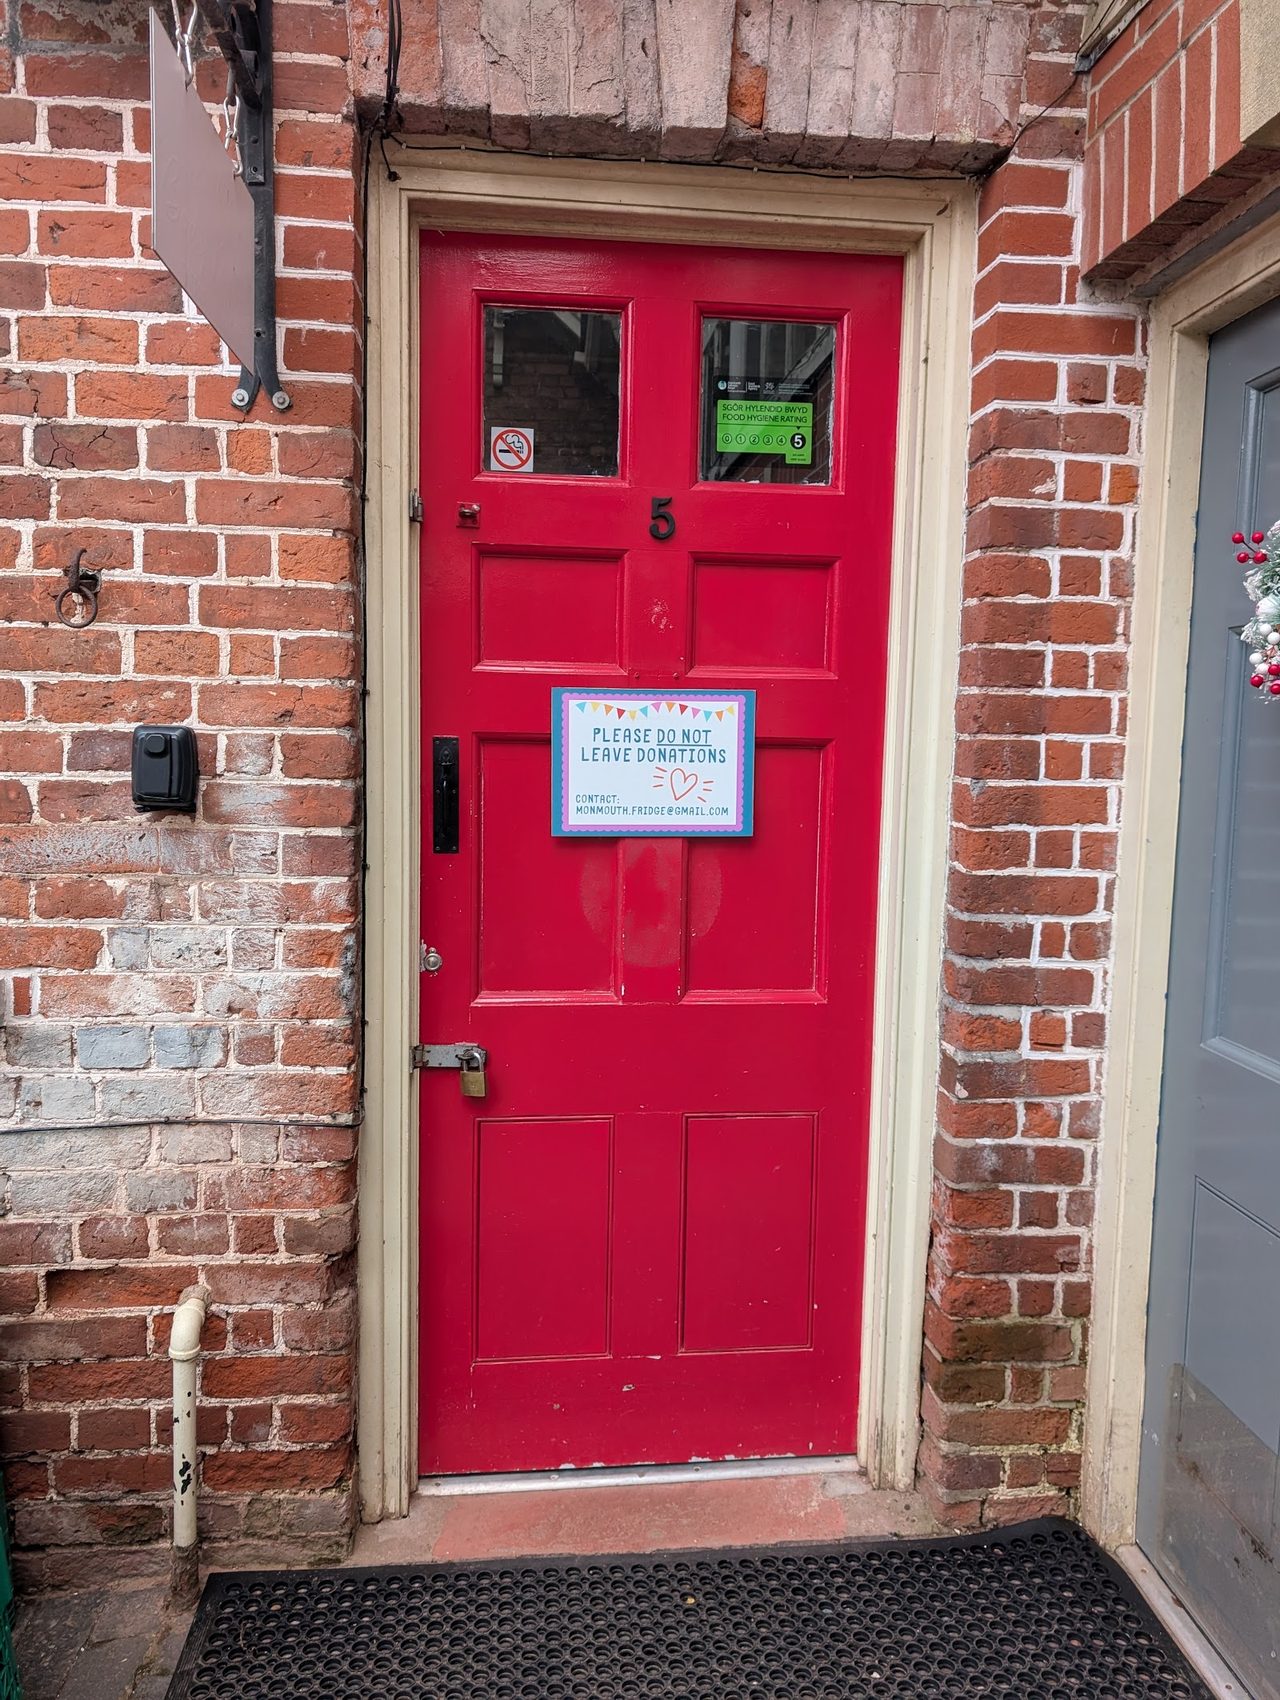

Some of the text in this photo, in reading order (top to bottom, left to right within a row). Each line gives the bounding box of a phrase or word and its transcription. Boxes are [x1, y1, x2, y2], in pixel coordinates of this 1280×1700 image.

[745, 404, 782, 413] HYLENDID
[784, 406, 808, 414] BWYD
[722, 413, 745, 421] FOOD
[747, 415, 779, 423] HYGIENE
[794, 435, 803, 447] 5
[650, 496, 675, 540] 5
[592, 727, 712, 744] PLEASE DO NOT
[581, 747, 727, 763] LEAVE DONATIONS
[575, 794, 620, 804] CONTACT:
[575, 805, 729, 816] MONMOUTH.FRIDGE@GMAIL.COM
